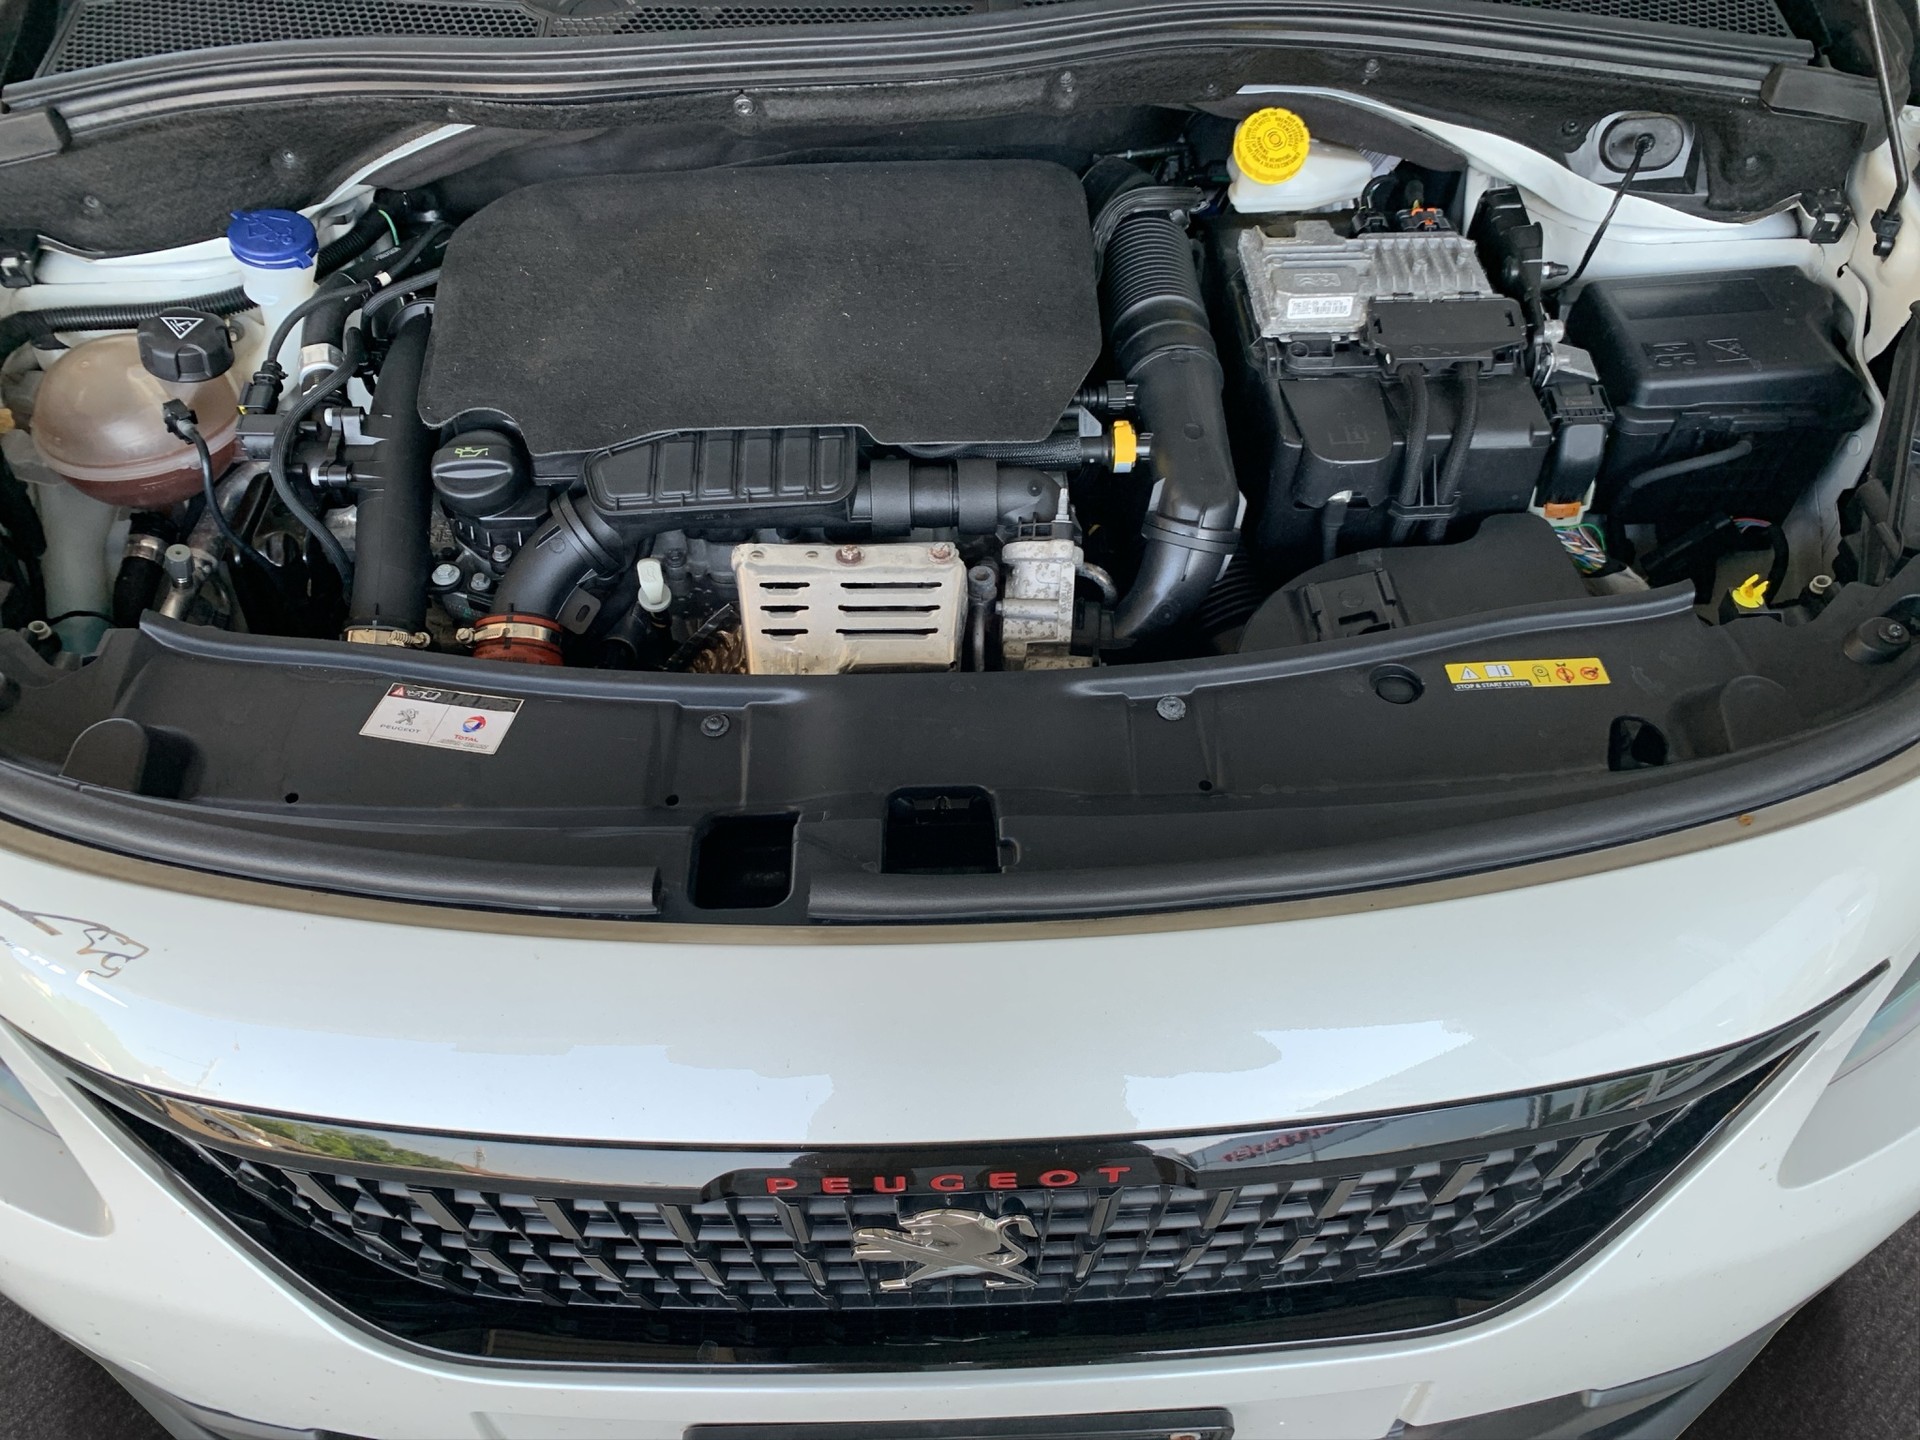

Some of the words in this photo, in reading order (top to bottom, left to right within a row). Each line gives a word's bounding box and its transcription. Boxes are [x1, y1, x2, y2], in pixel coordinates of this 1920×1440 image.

[380, 723, 422, 734] PEUGEOT
[454, 734, 479, 743] TOTAL
[766, 1166, 1132, 1194] PEUGEOT
